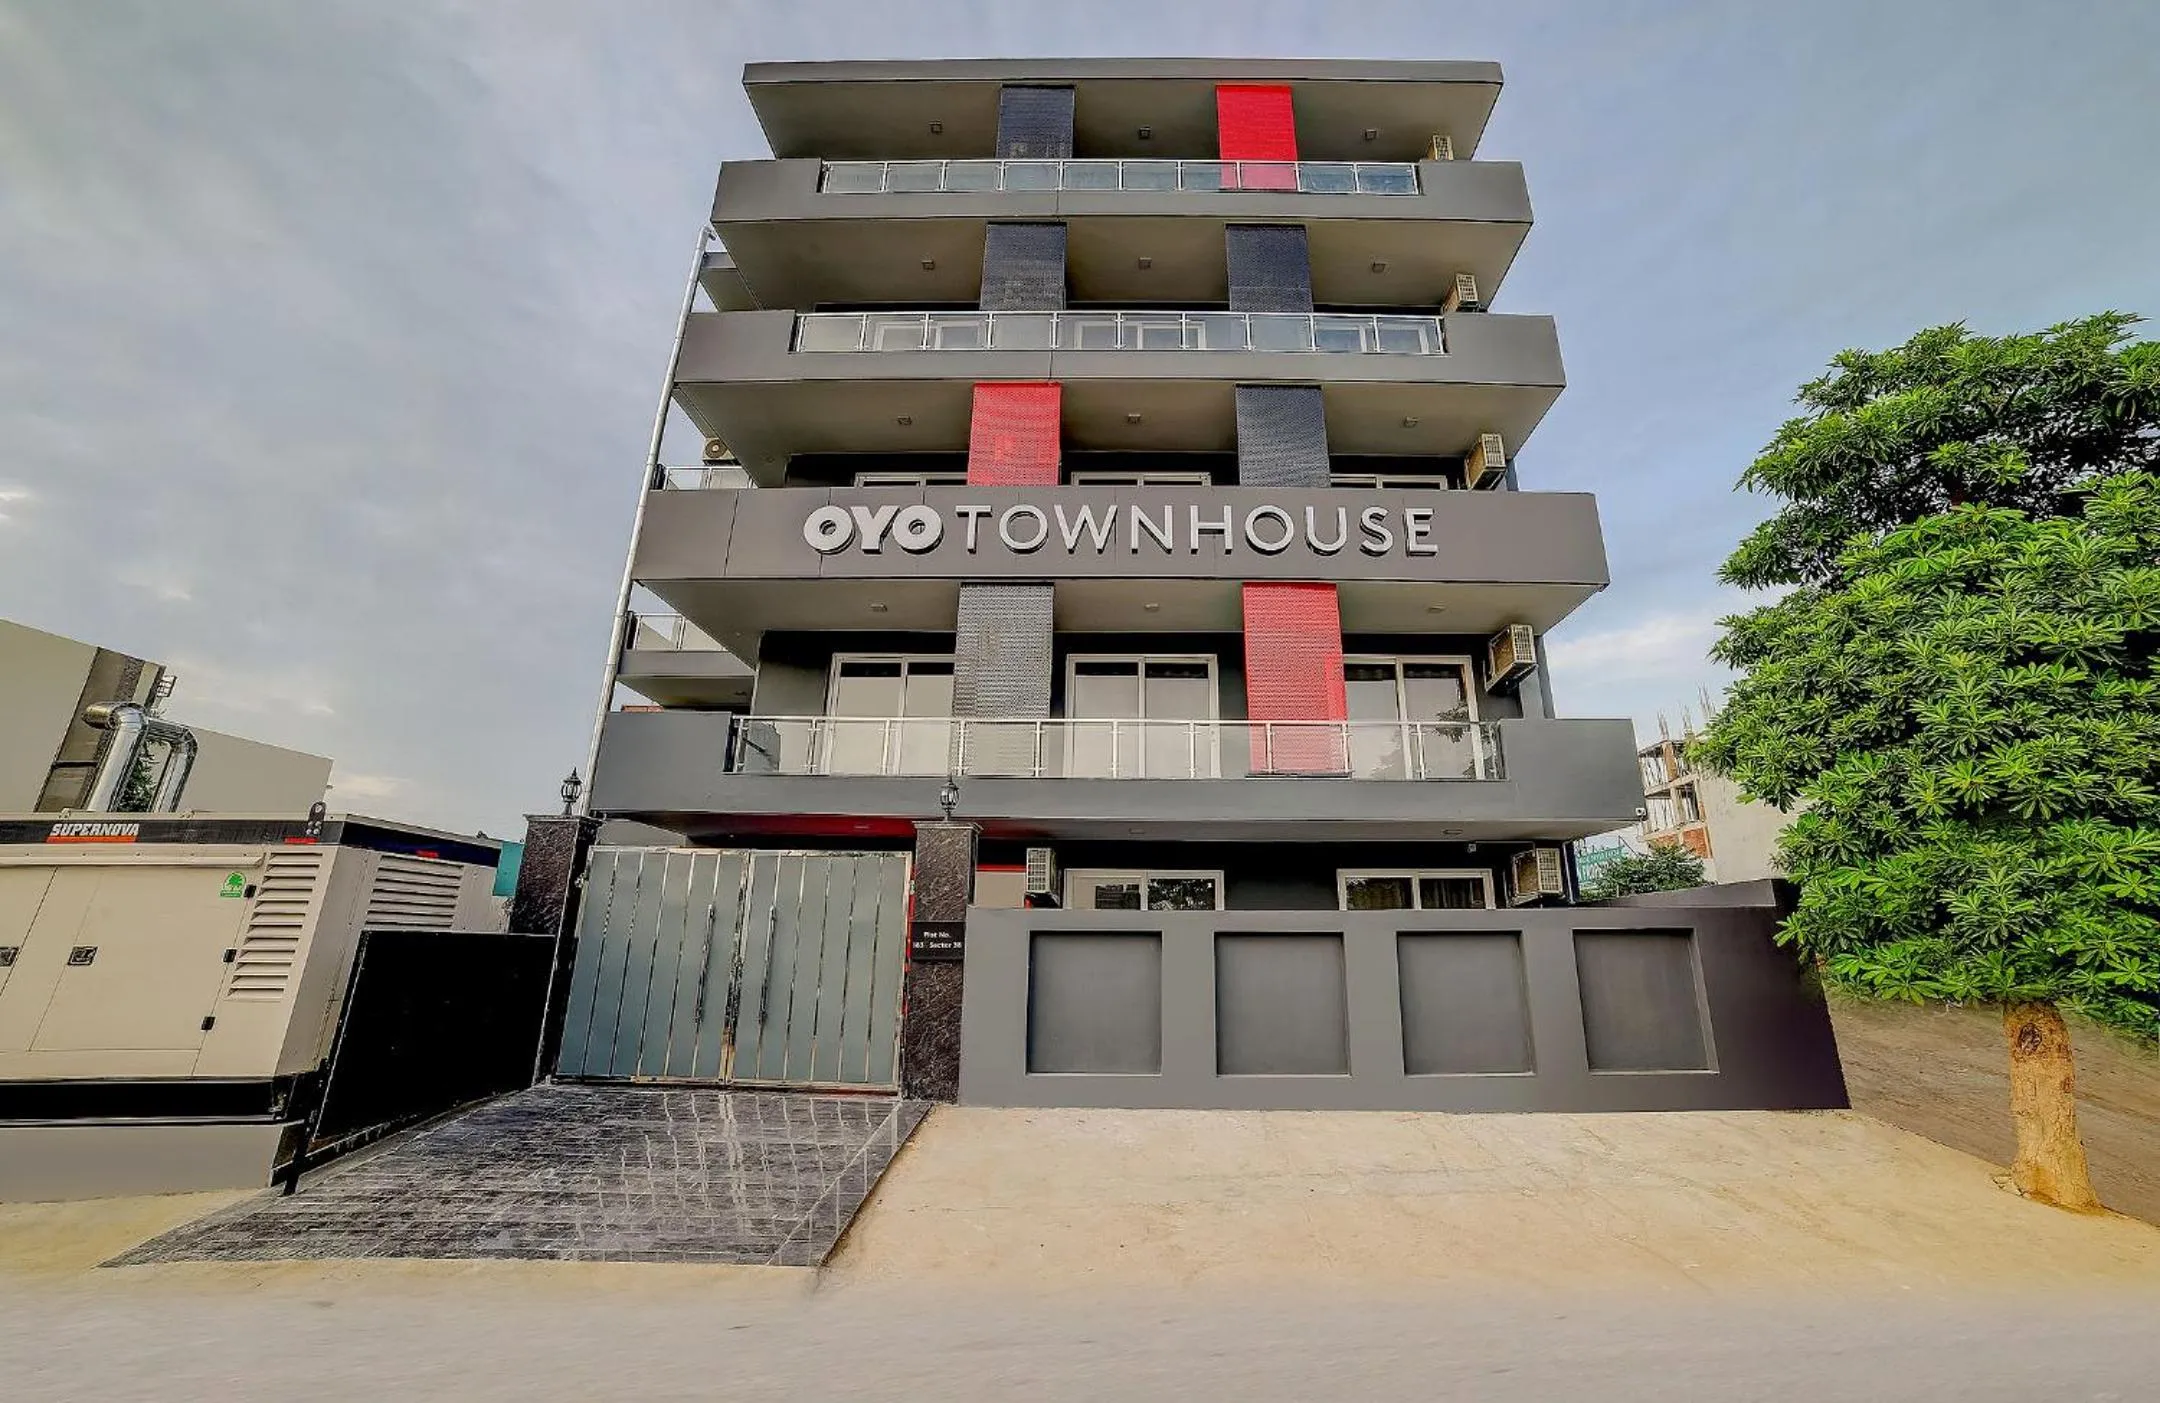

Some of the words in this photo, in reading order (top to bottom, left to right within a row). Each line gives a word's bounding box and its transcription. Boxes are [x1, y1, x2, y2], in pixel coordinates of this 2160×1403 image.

[803, 504, 944, 555] OYO
[955, 503, 1439, 557] TOWNHOUSE
[49, 823, 140, 837] SUPERNOVA
[929, 941, 952, 949] Sector
